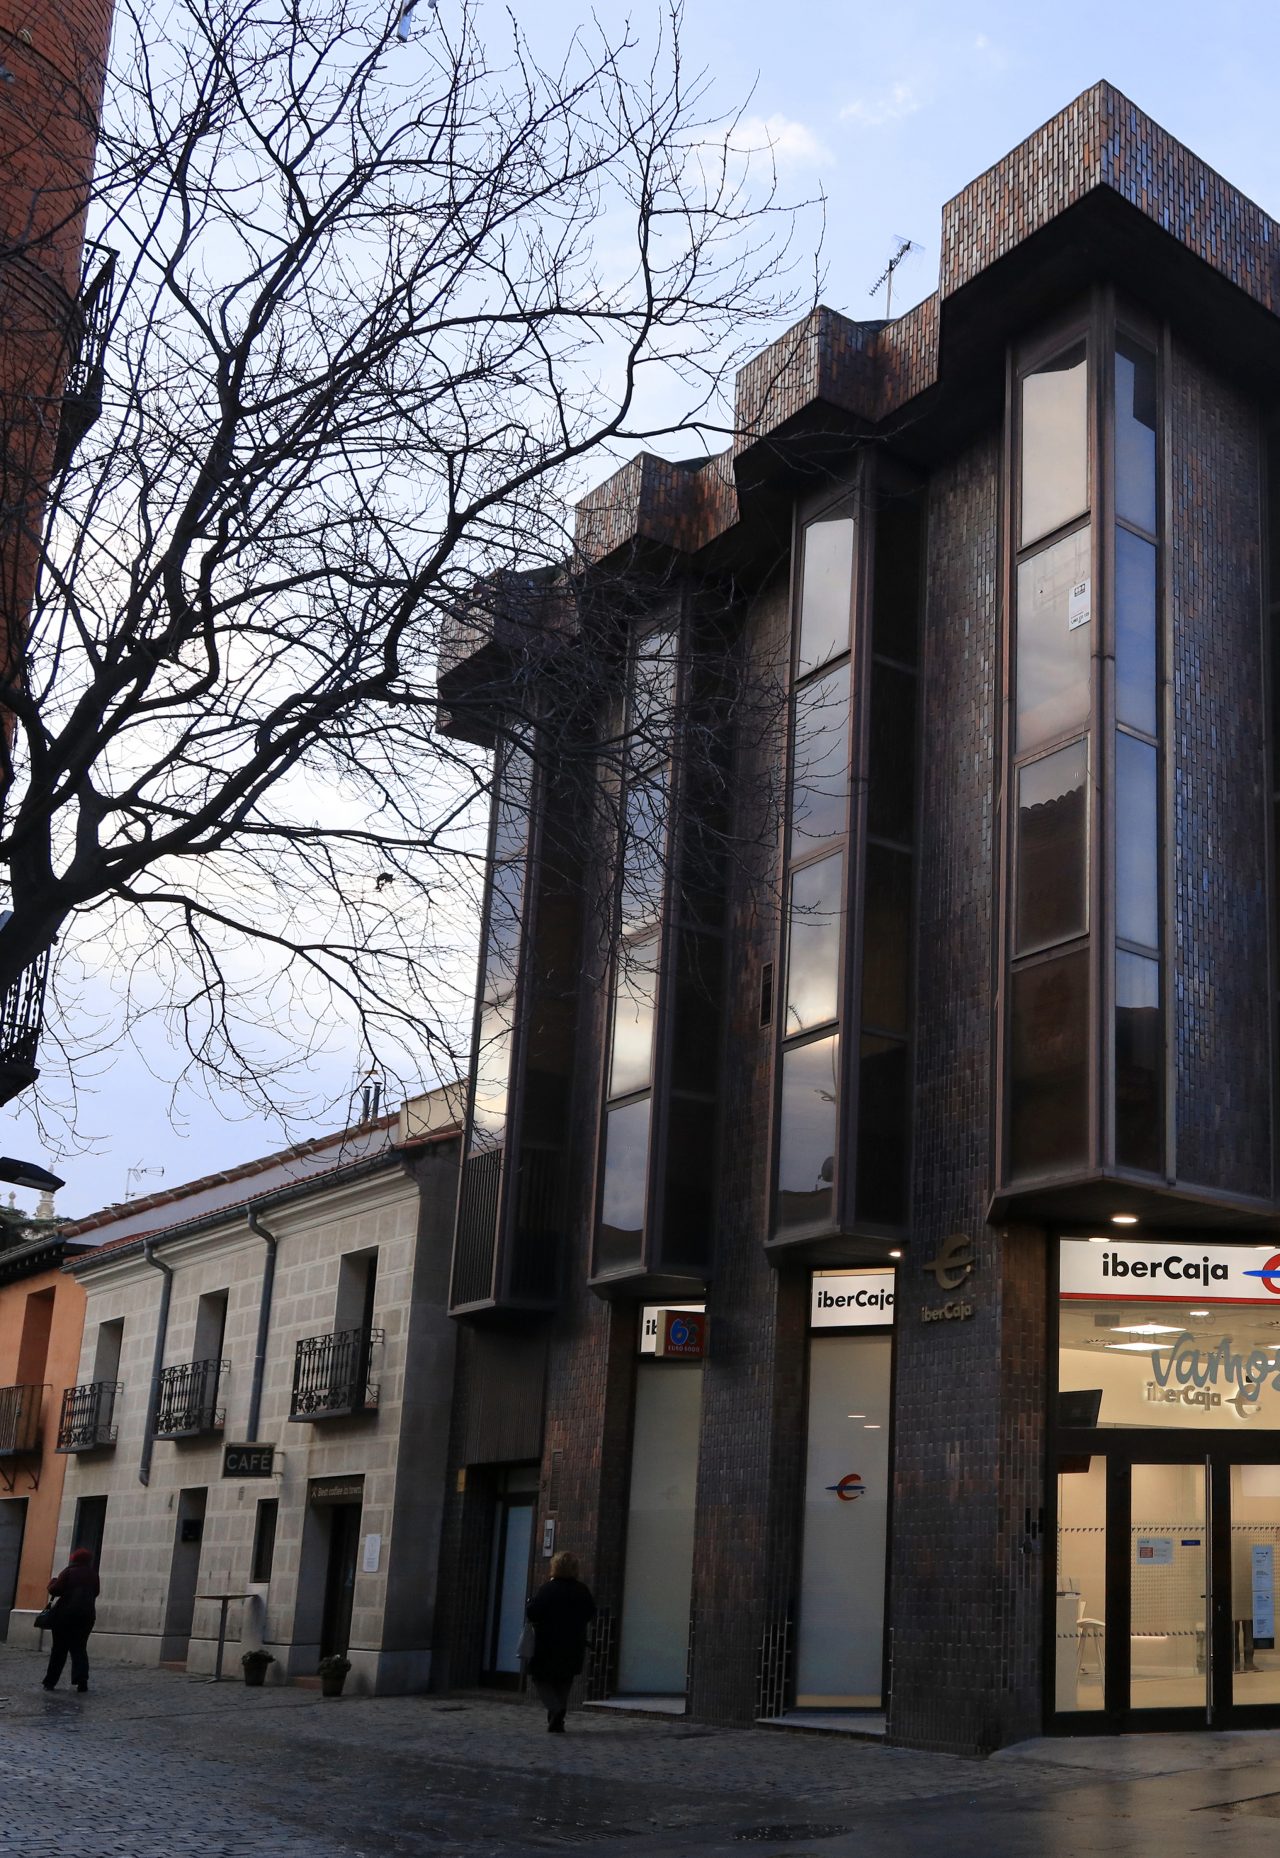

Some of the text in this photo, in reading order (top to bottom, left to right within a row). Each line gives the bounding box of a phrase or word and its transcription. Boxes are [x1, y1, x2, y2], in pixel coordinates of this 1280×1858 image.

[1102, 1253, 1229, 1287] iberCaja
[817, 1289, 895, 1310] iberCaja
[921, 1301, 973, 1323] iberCaja
[684, 1345, 700, 1353] 6000
[1145, 1381, 1222, 1411] iberCaja
[226, 1450, 271, 1470] CAFÉ
